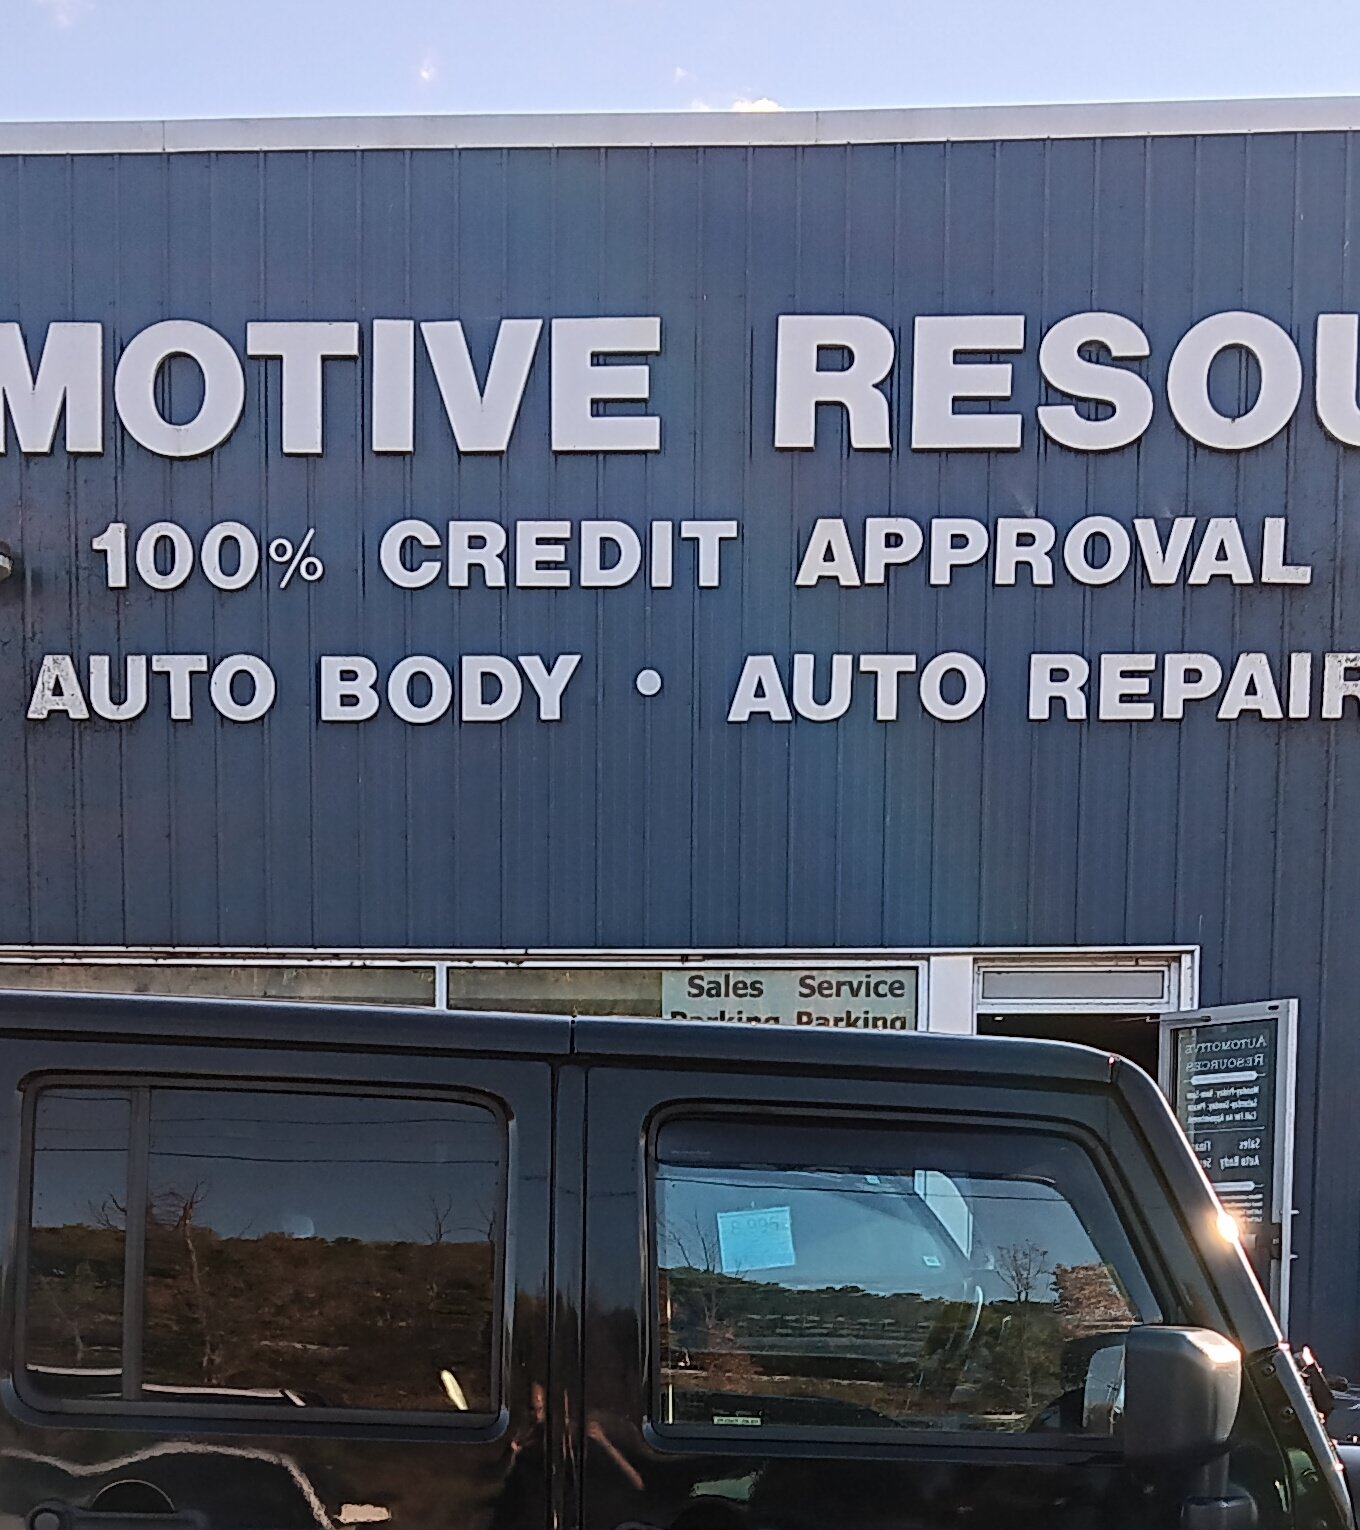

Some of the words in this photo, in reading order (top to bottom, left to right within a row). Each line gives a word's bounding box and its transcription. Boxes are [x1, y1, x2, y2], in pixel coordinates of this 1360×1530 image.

[91, 521, 325, 591] 100%
[379, 518, 739, 589] CREDIT
[795, 515, 1313, 588] APPROVAL
[26, 653, 277, 723] AUTO
[319, 653, 582, 724] BODY
[727, 652, 987, 723] AUTO
[687, 974, 764, 998] Sales
[798, 974, 906, 998] Service
